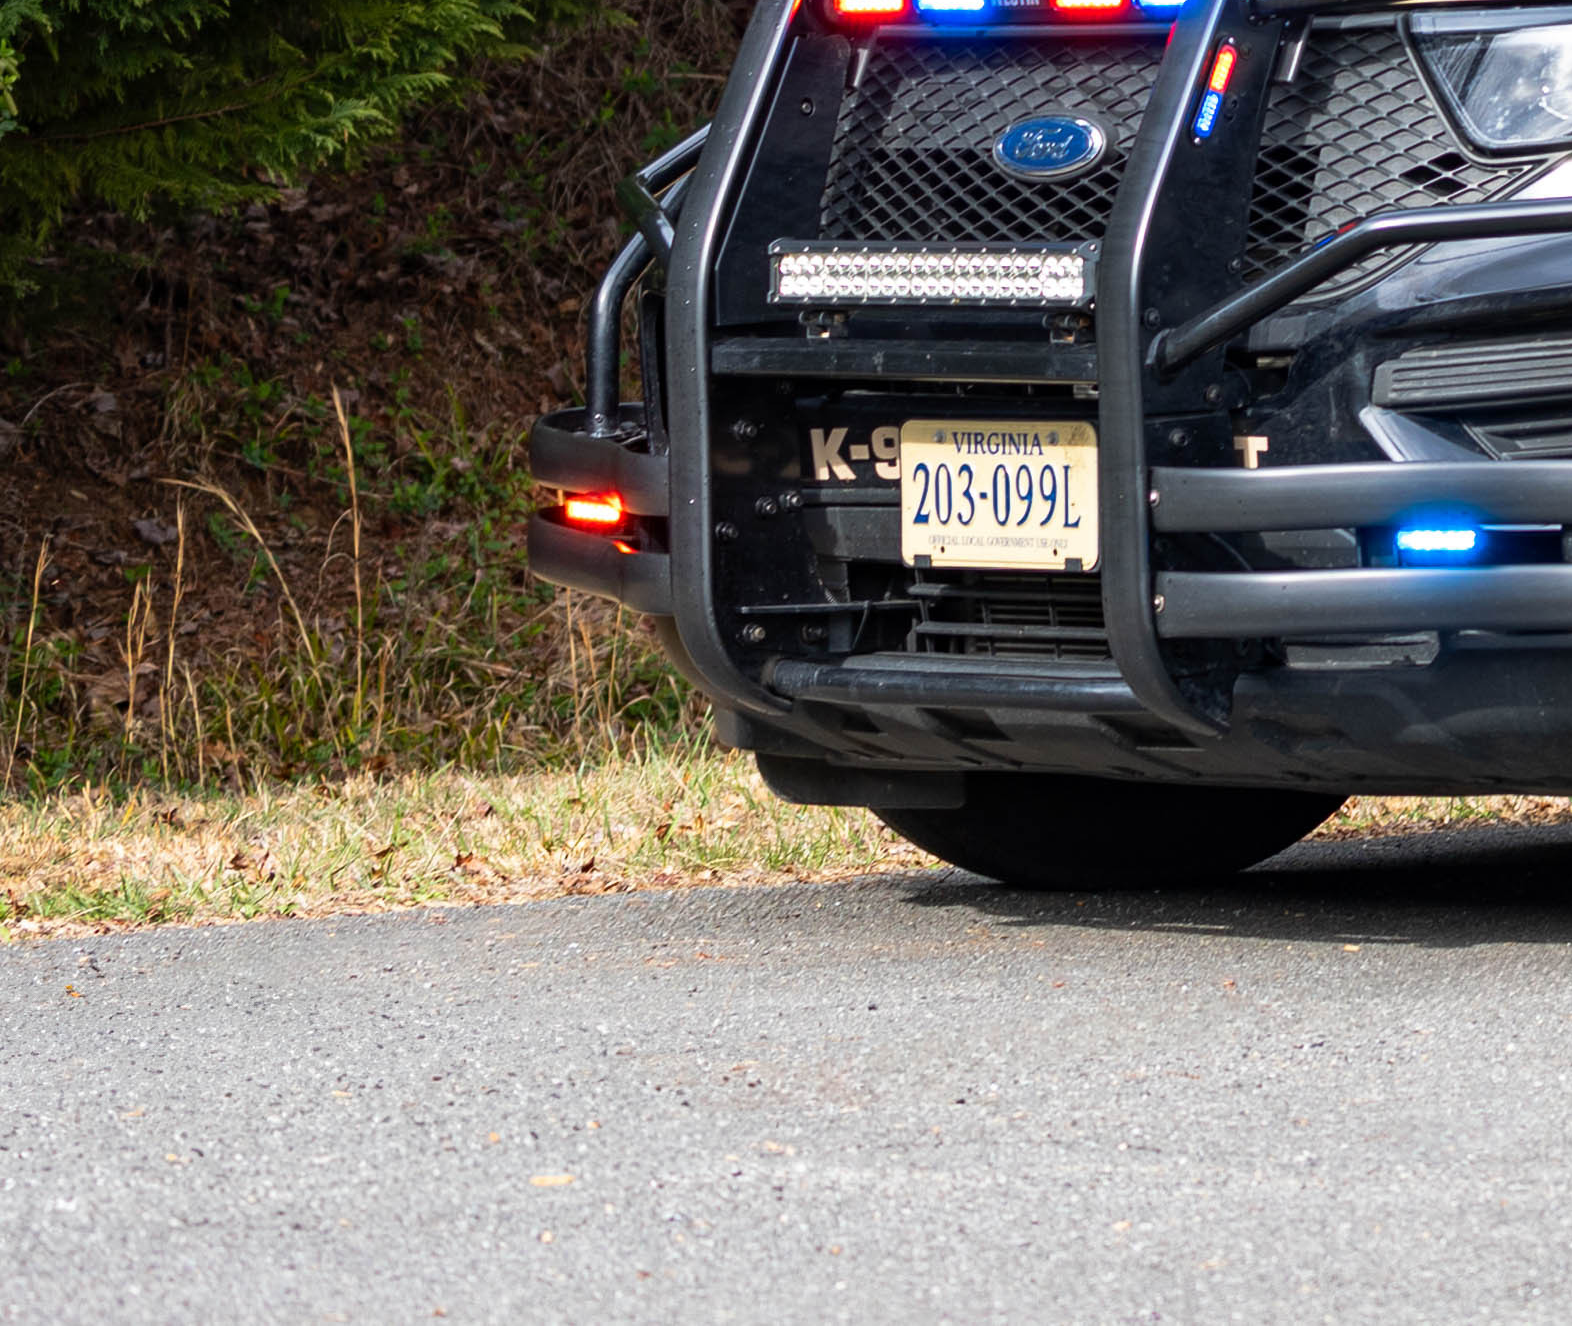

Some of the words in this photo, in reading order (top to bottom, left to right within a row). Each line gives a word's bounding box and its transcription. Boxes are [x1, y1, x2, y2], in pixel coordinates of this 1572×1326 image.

[810, 426, 901, 480] K-9
[952, 432, 1044, 455] VIRGINIA
[913, 462, 1081, 528] 203-099L
